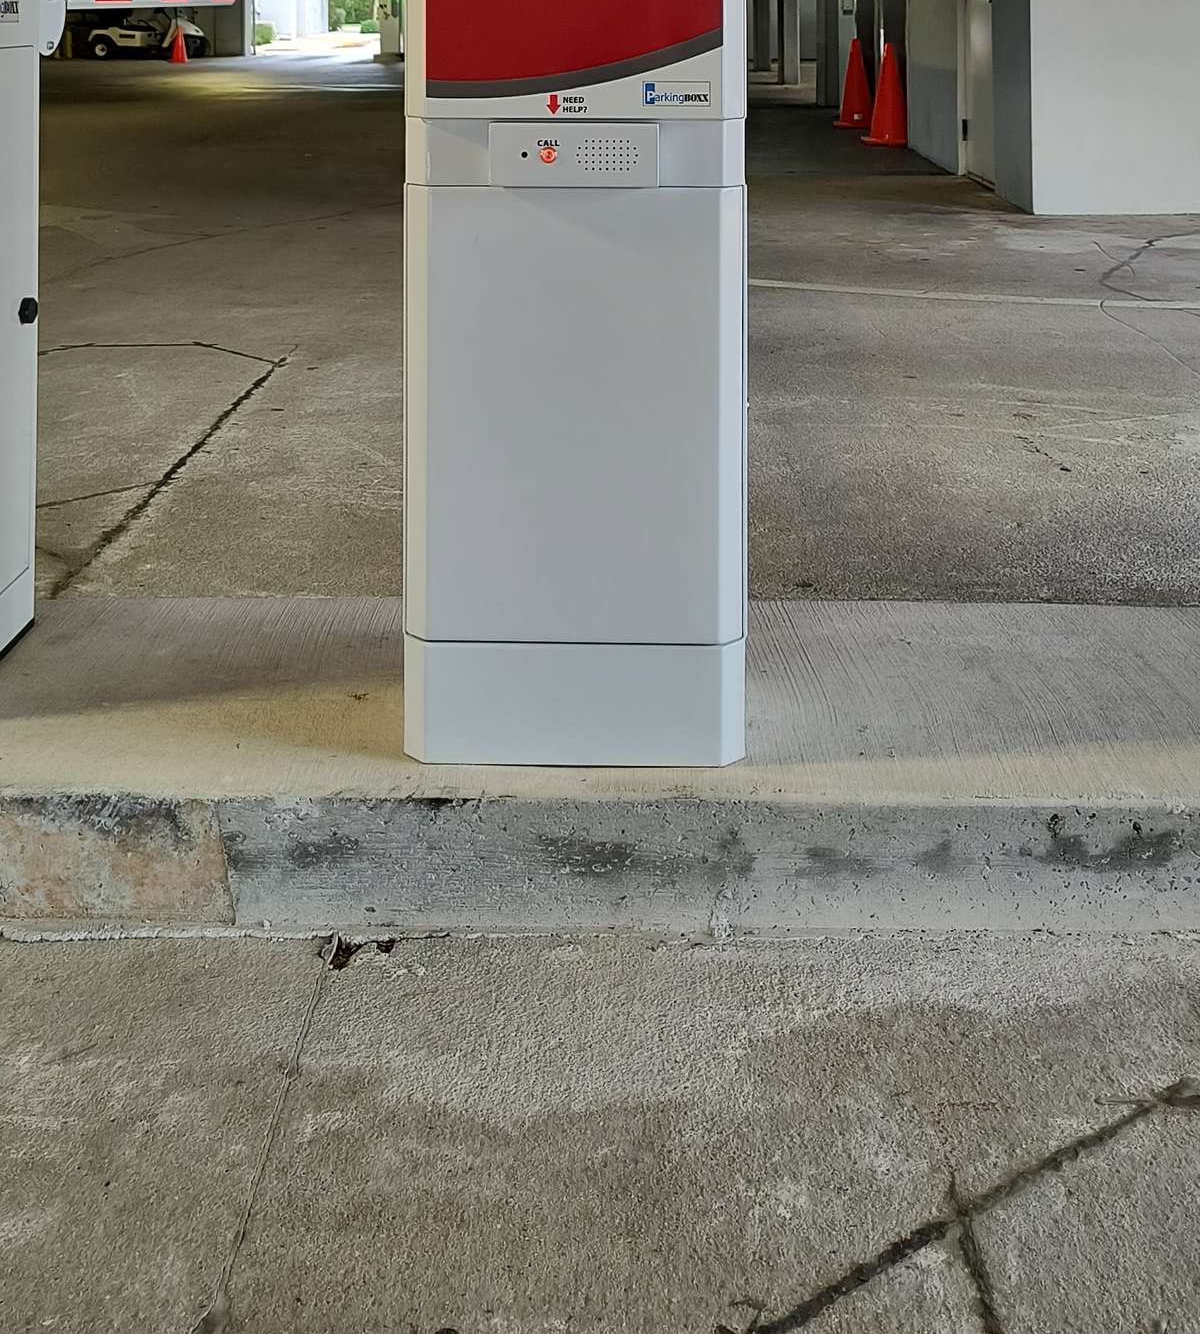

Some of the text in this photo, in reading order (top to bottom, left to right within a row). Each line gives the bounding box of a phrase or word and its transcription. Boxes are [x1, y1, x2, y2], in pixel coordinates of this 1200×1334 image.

[645, 90, 709, 104] ParkingBOXX
[562, 106, 588, 114] HELP?
[537, 139, 560, 147] CALL
